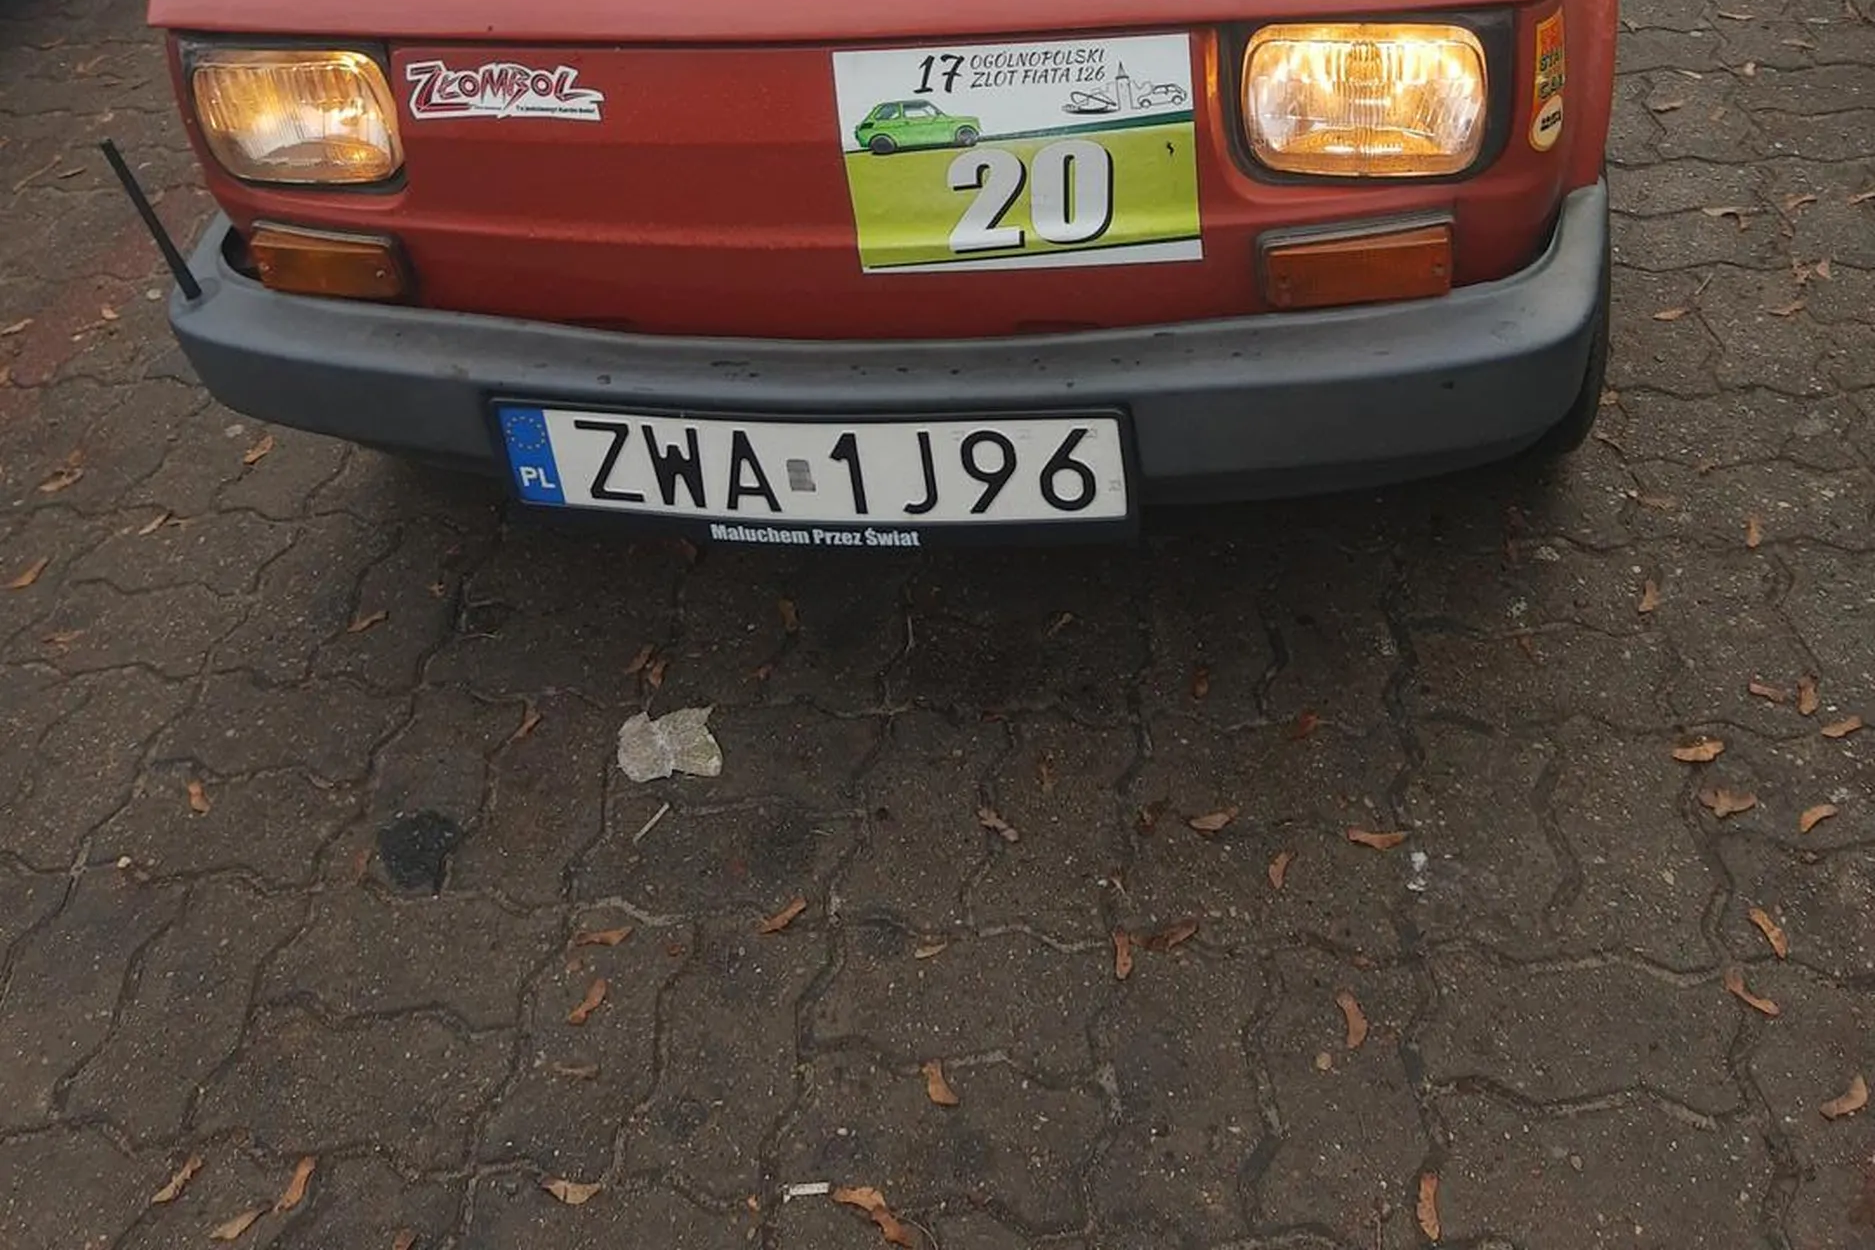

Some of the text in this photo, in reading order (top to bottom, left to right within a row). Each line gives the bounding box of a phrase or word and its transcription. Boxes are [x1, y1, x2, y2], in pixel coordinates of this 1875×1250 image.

[912, 48, 1106, 94] 17 OGÓLNOPOLSKI
[970, 65, 1106, 89] ZLOT FIATA 126
[947, 138, 1115, 254] 20
[520, 465, 556, 489] PL
[573, 417, 1099, 516] ZWA 1J96
[709, 522, 922, 547] Maluchem Przez Świat
